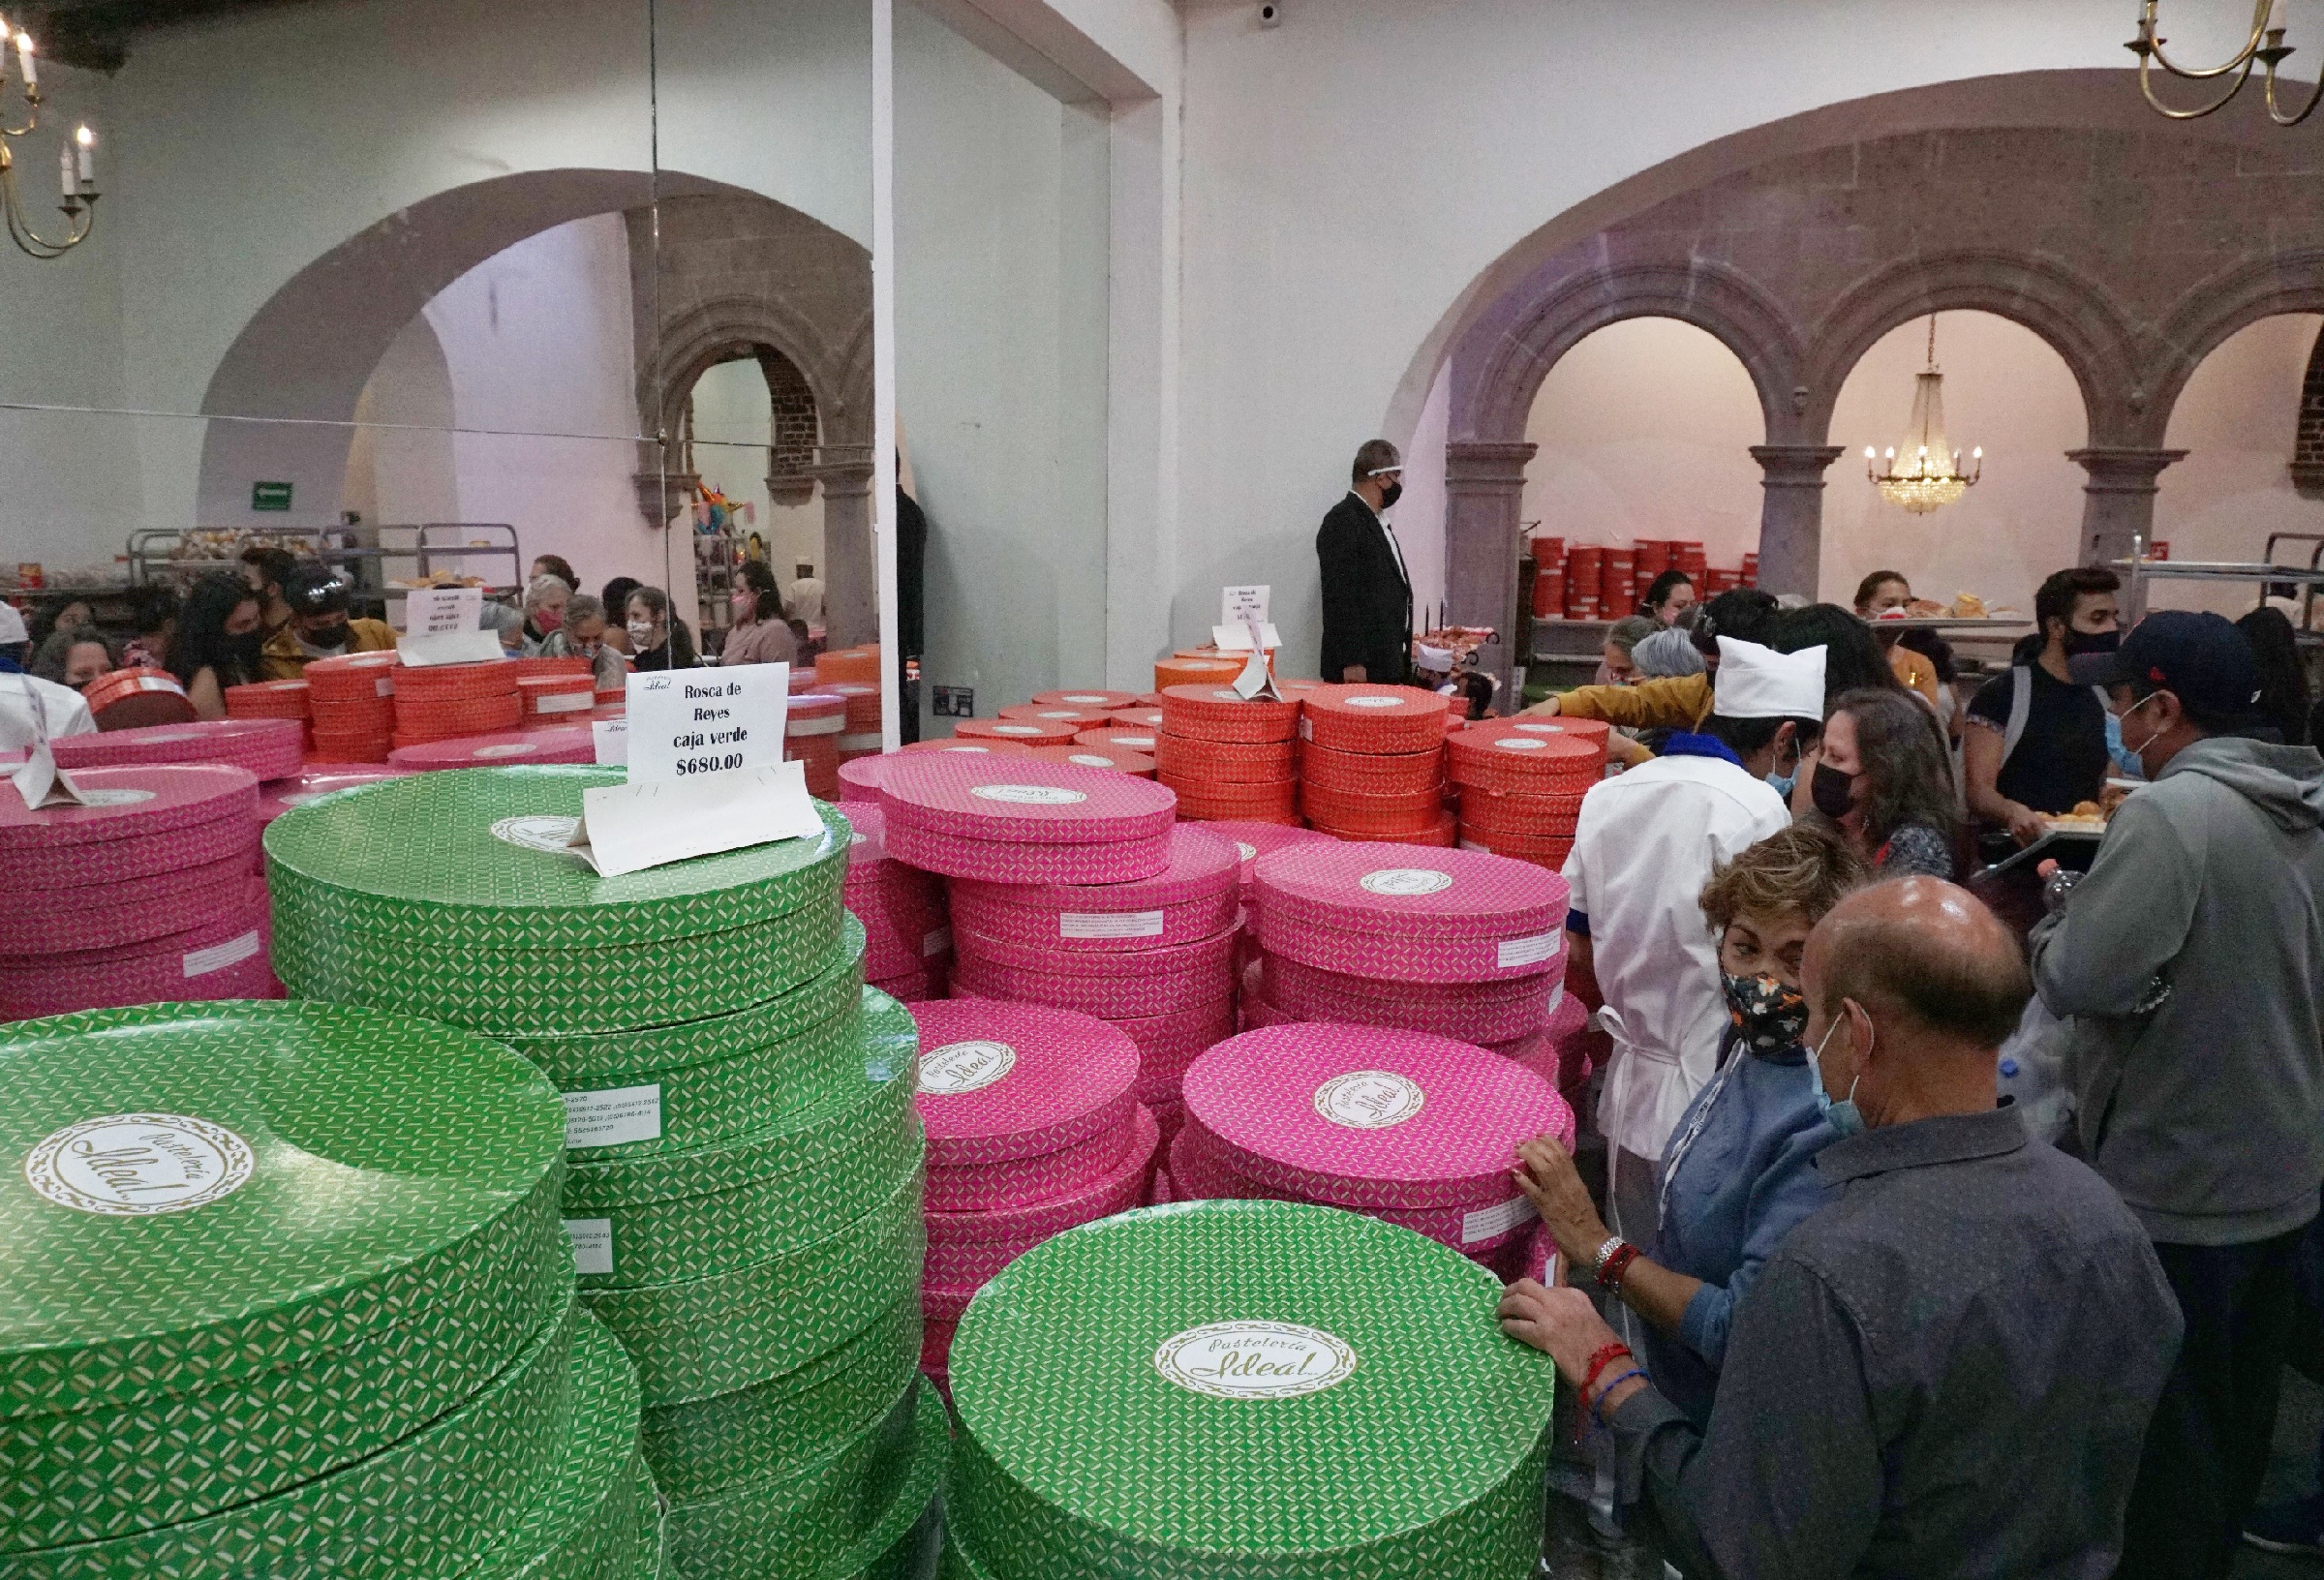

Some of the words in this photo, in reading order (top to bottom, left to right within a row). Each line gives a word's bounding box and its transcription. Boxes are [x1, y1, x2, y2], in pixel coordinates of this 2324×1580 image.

[685, 684, 722, 699] Rosca
[726, 682, 742, 696] de
[693, 708, 730, 722] Reyes
[673, 731, 704, 750] caja
[710, 726, 748, 744] verde
[676, 752, 744, 776] $680.00
[71, 1139, 191, 1196] Ideal
[1208, 1337, 1308, 1353] Pastelería
[1189, 1351, 1318, 1380] Ideal
